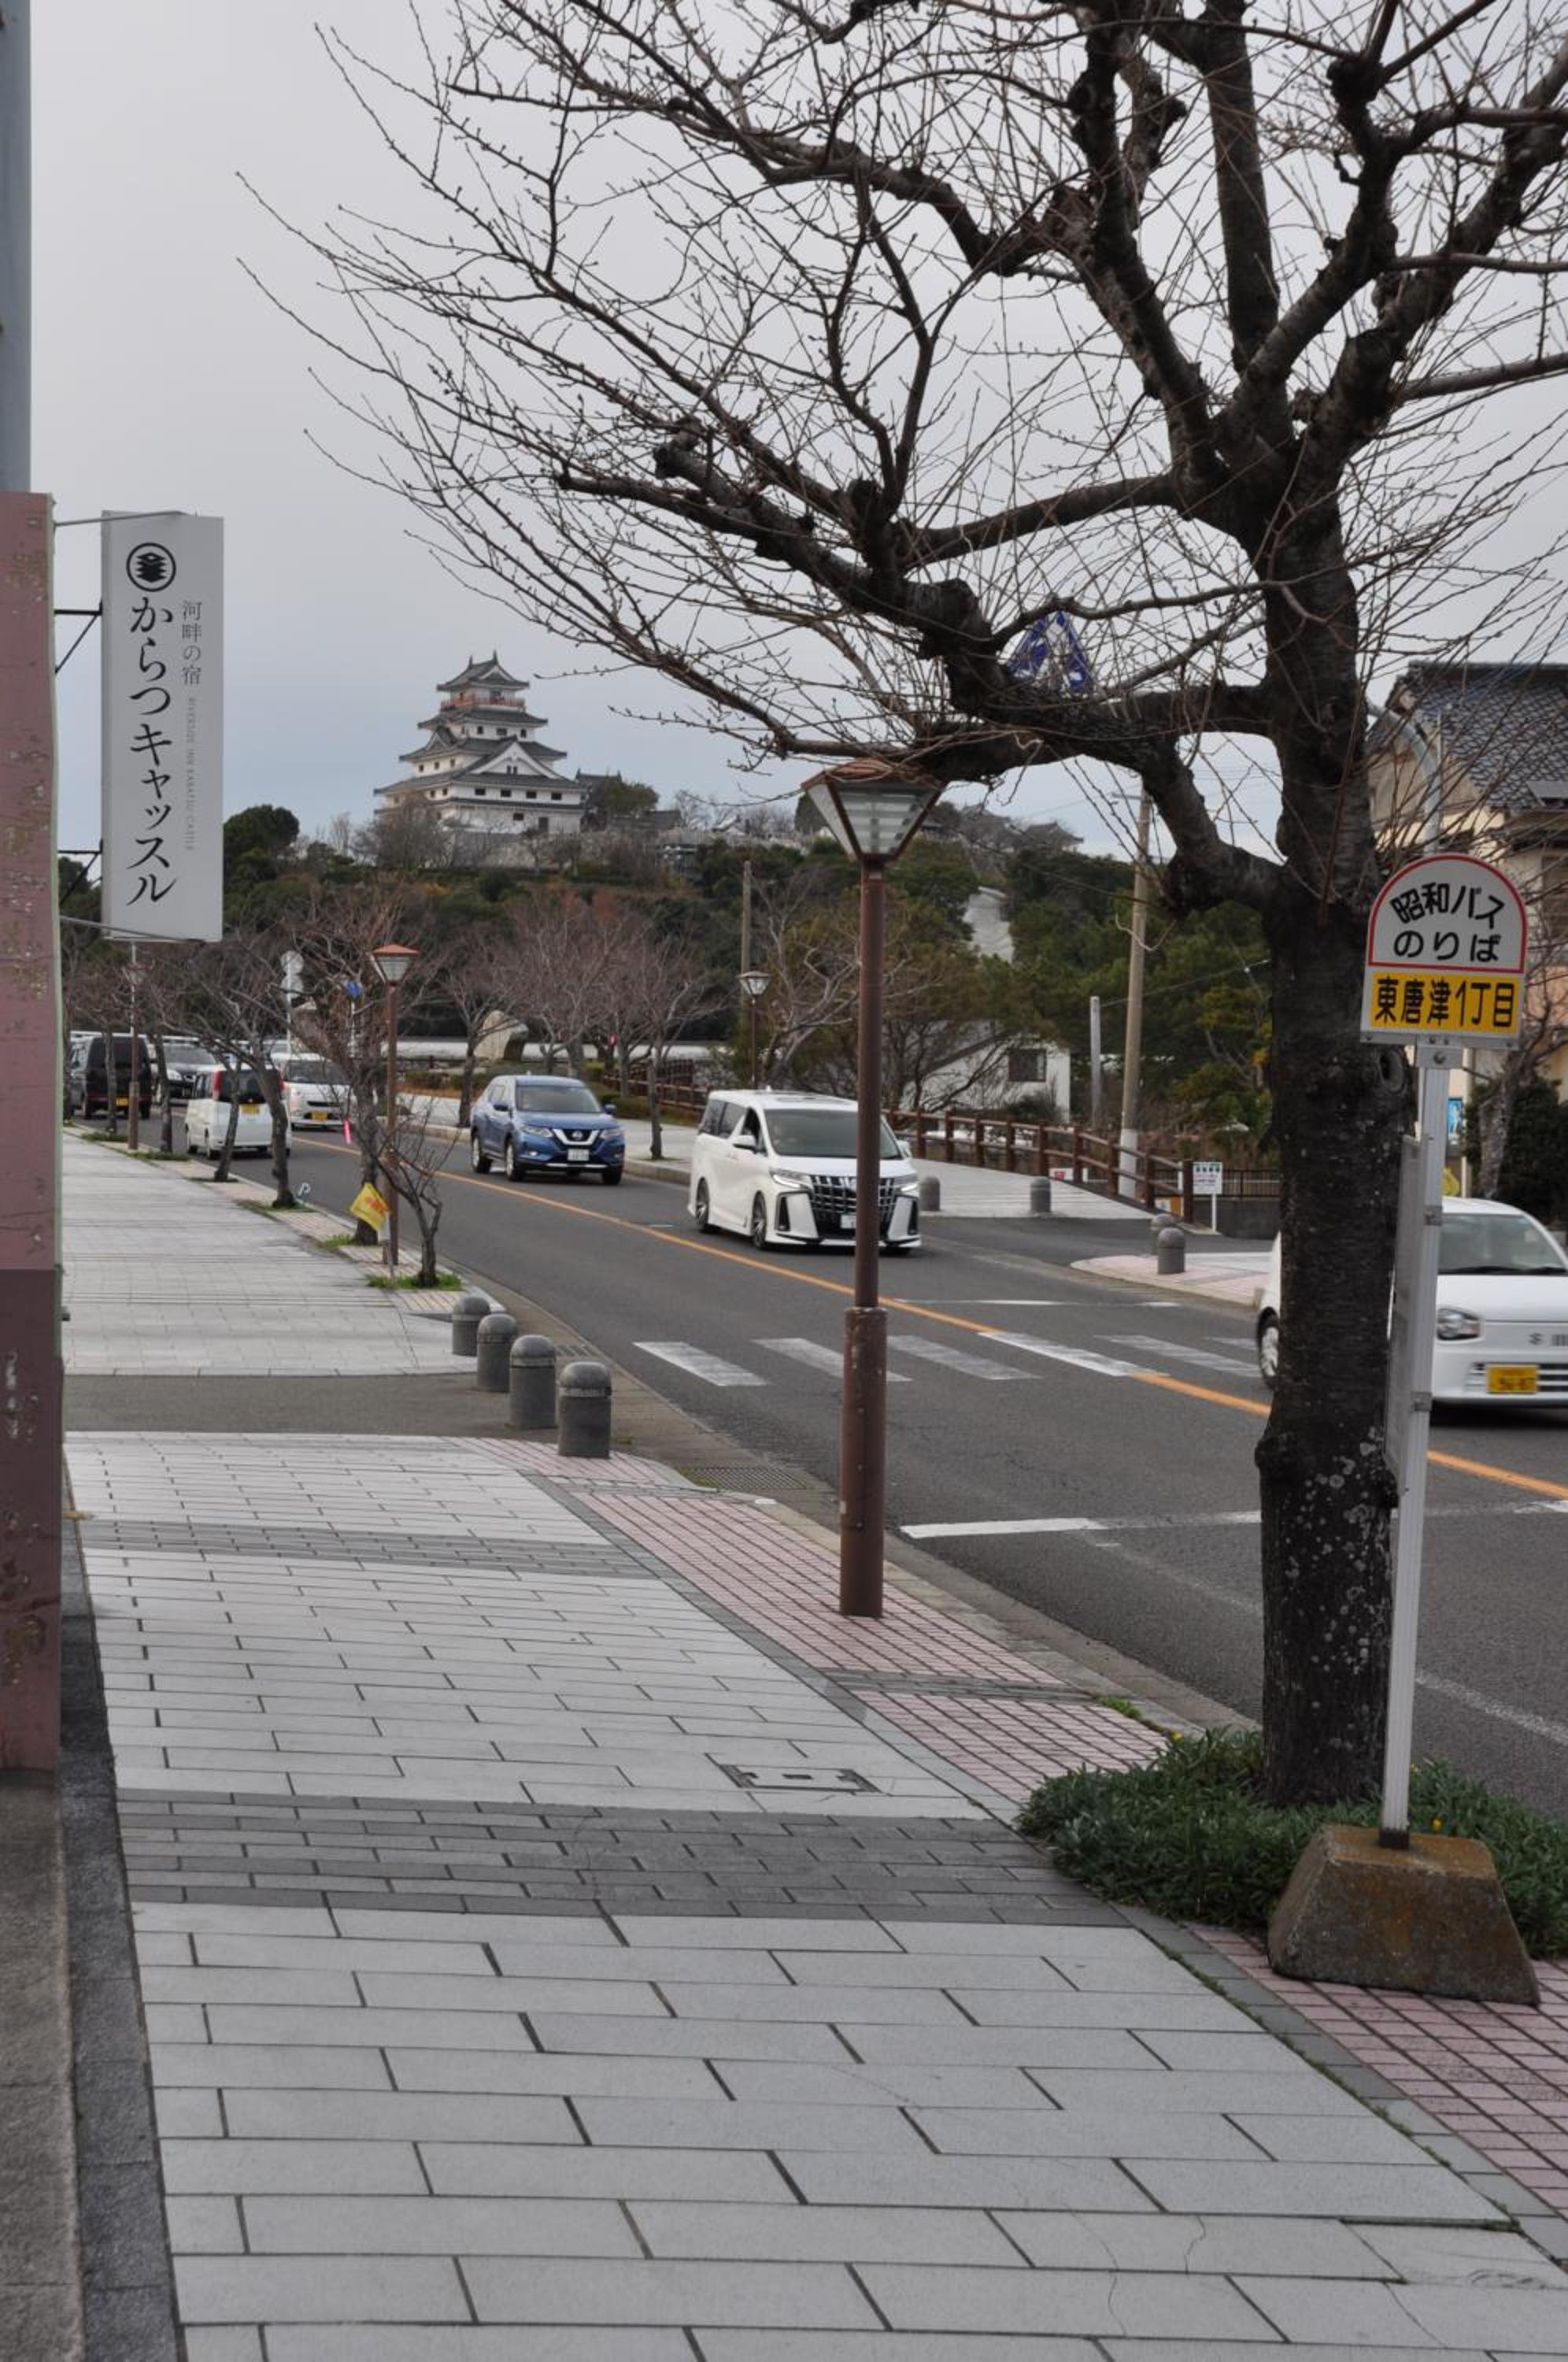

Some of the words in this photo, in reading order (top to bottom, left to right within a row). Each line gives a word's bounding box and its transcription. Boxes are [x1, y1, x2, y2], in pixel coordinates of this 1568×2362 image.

[181, 600, 202, 685] 河畔の宿
[127, 597, 177, 905] からつキャッスル
[1390, 881, 1505, 929] 昭和バス
[1393, 929, 1502, 963] のりば
